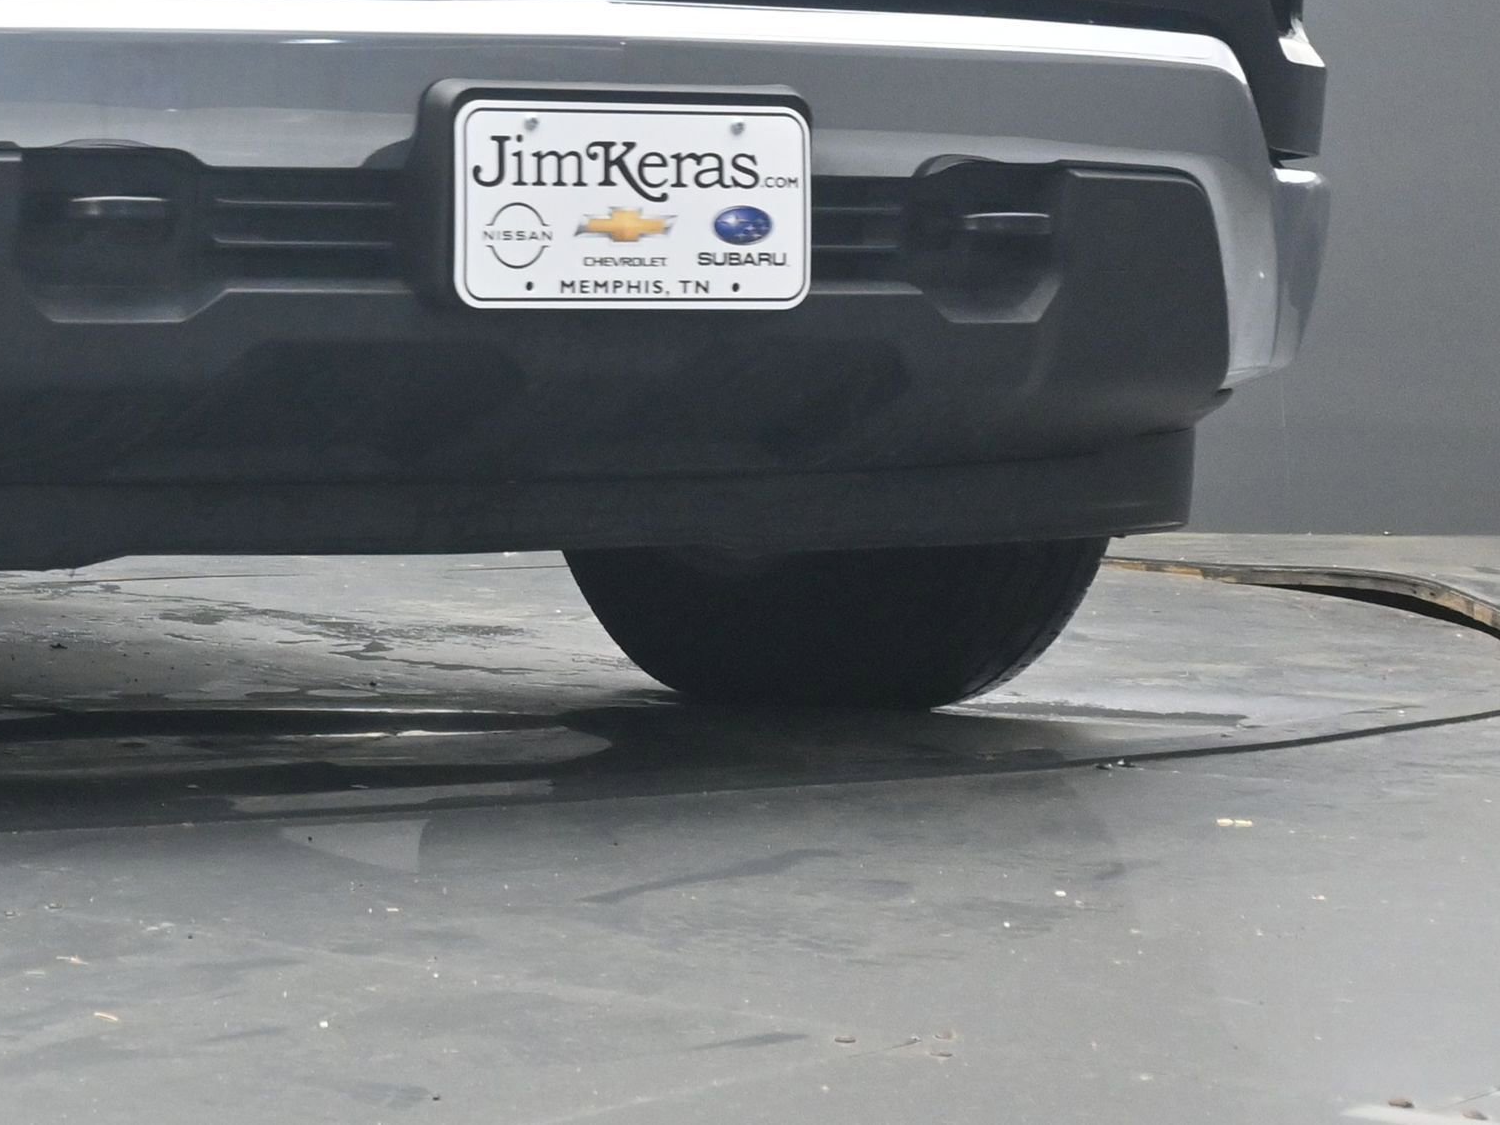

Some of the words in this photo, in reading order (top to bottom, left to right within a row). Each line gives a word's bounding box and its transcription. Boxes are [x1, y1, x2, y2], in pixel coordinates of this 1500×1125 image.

[482, 230, 553, 241] NISSAN
[583, 256, 668, 267] CHEVROLET
[697, 252, 787, 266] SUBARU
[560, 280, 670, 296] MEMPHIS,
[679, 281, 710, 294] TN
